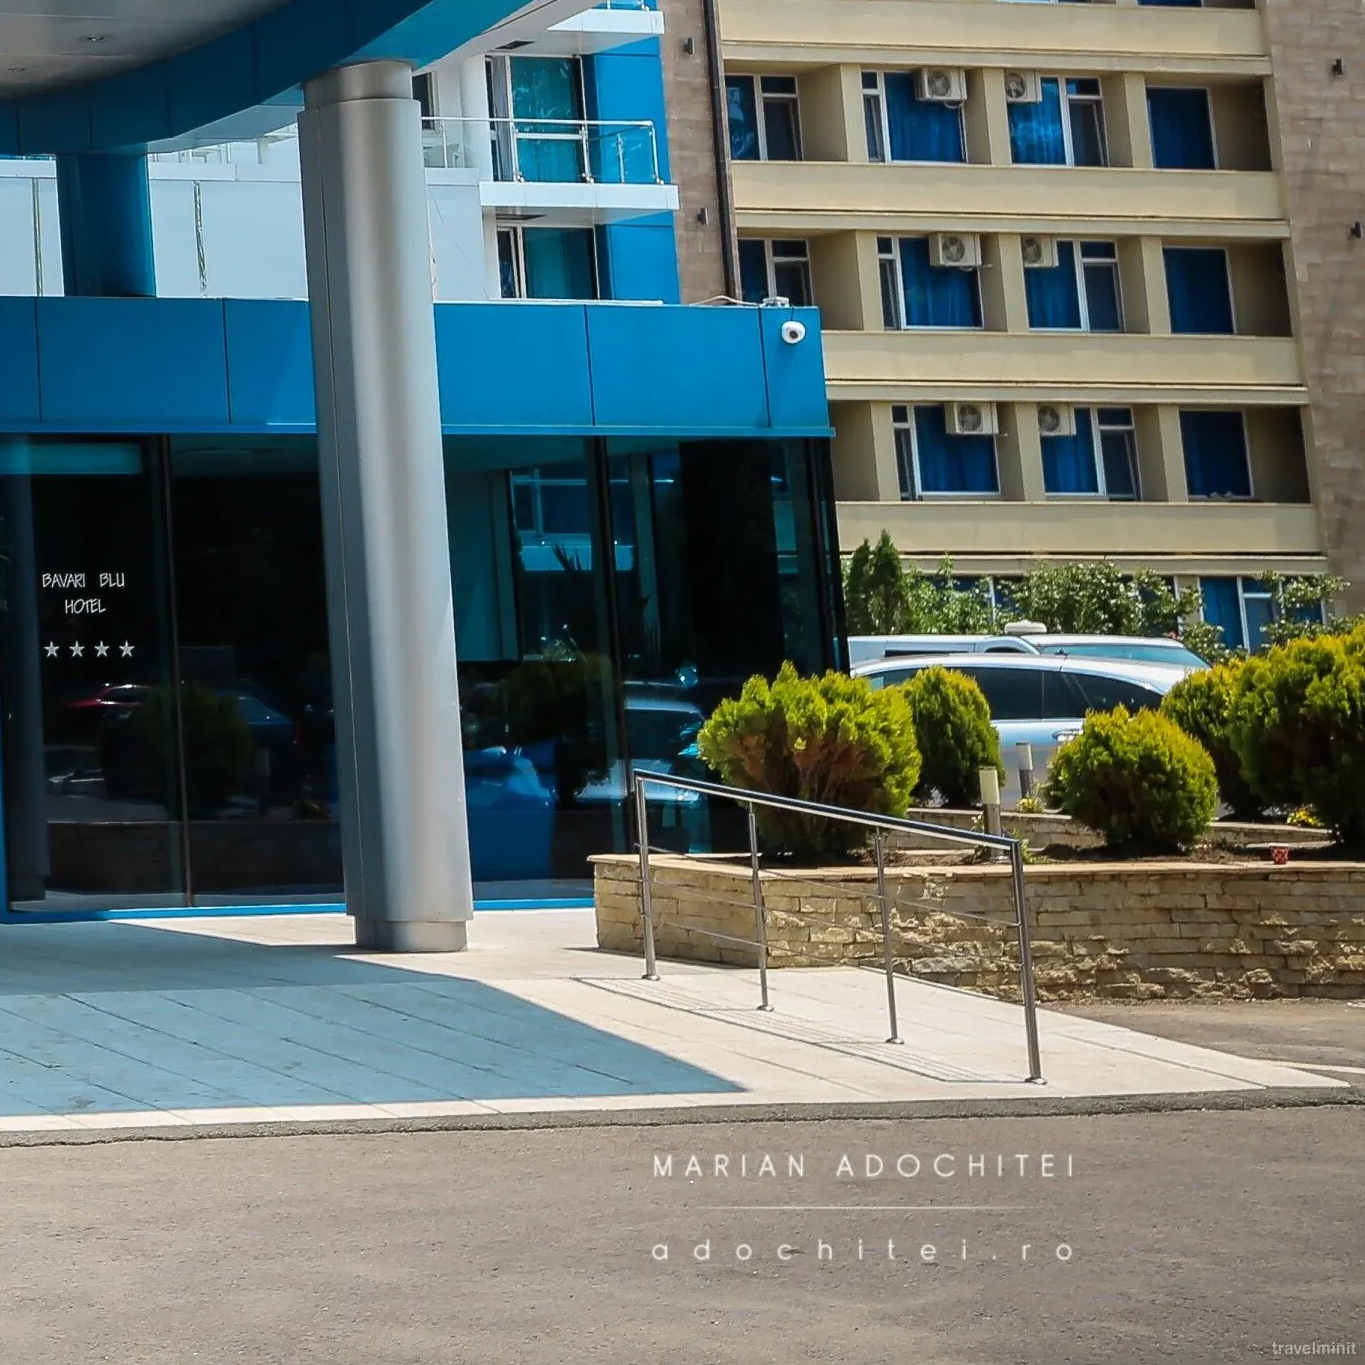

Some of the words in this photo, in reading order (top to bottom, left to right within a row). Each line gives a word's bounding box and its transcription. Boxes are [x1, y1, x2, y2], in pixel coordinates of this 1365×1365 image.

[41, 572, 86, 588] BAVARI
[99, 572, 126, 588] BLU
[64, 598, 107, 615] HOTEL
